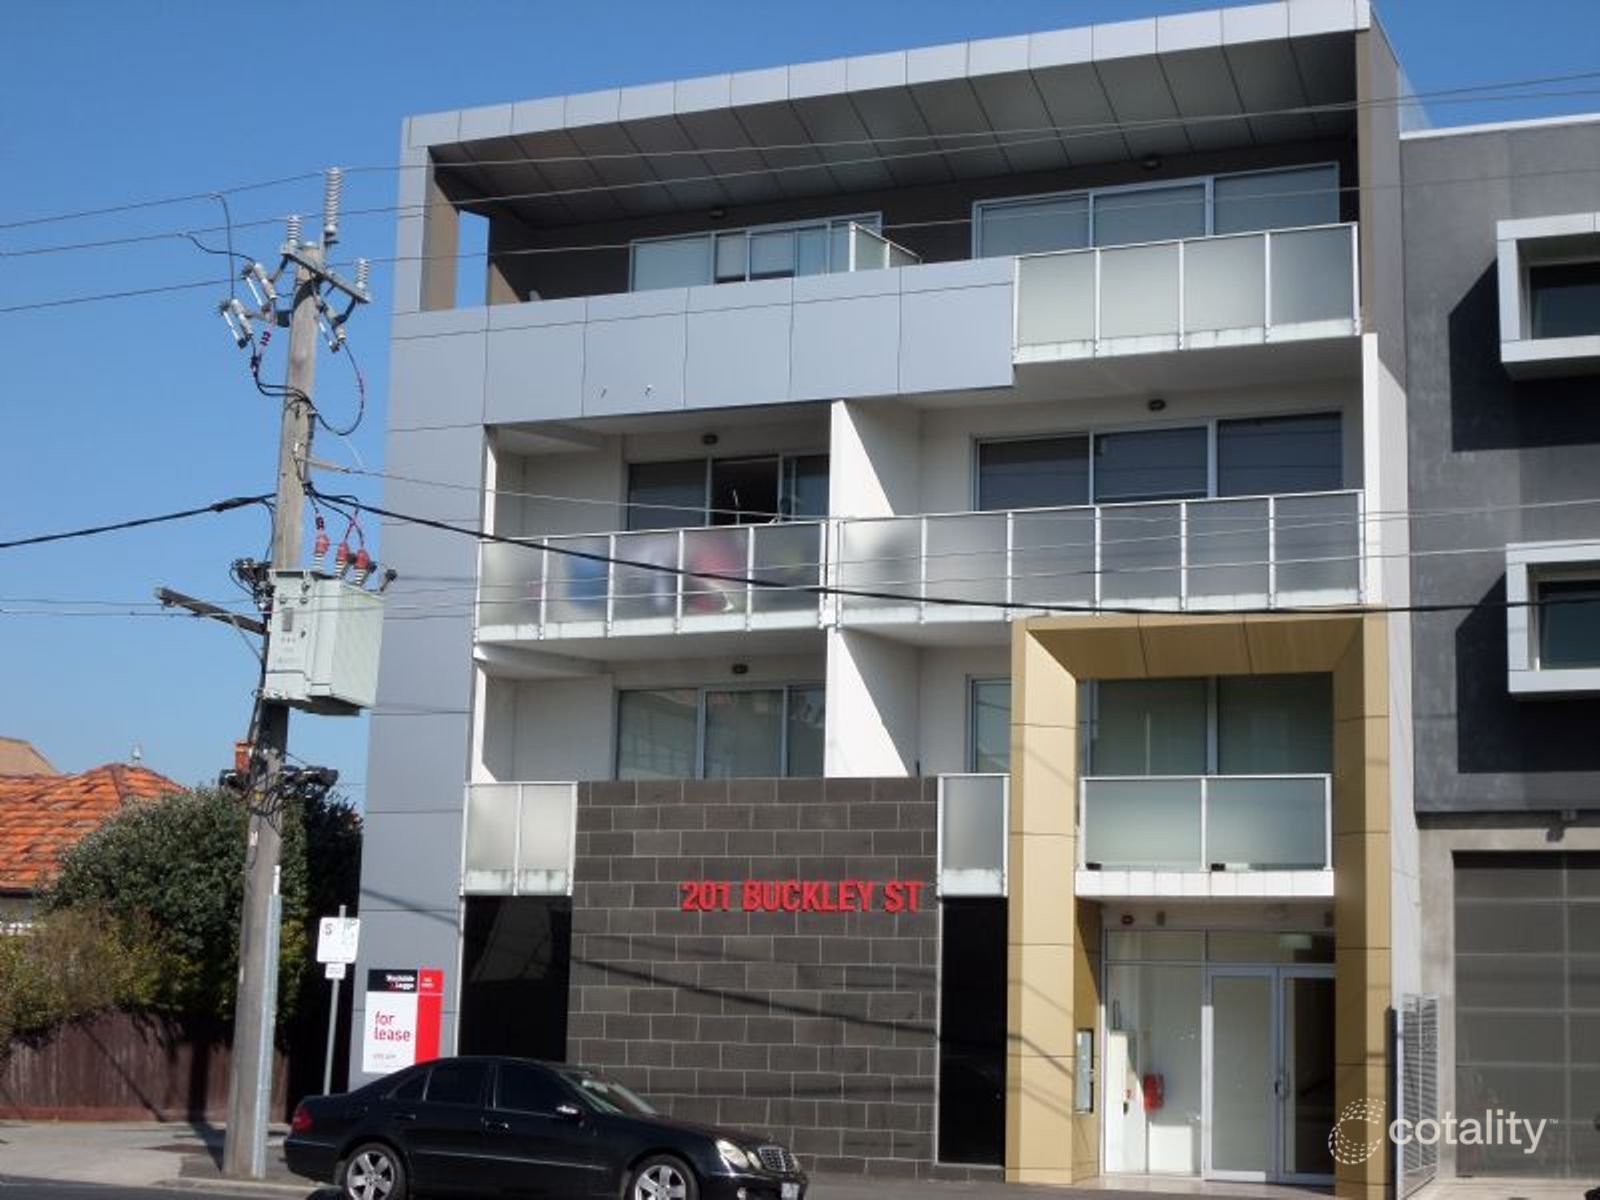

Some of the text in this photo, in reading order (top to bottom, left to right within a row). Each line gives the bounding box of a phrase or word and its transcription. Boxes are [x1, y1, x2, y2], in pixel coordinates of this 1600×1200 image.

[681, 880, 925, 912] 201 BUCKLEY ST
[375, 1010, 396, 1026] for
[374, 1026, 411, 1042] lease
